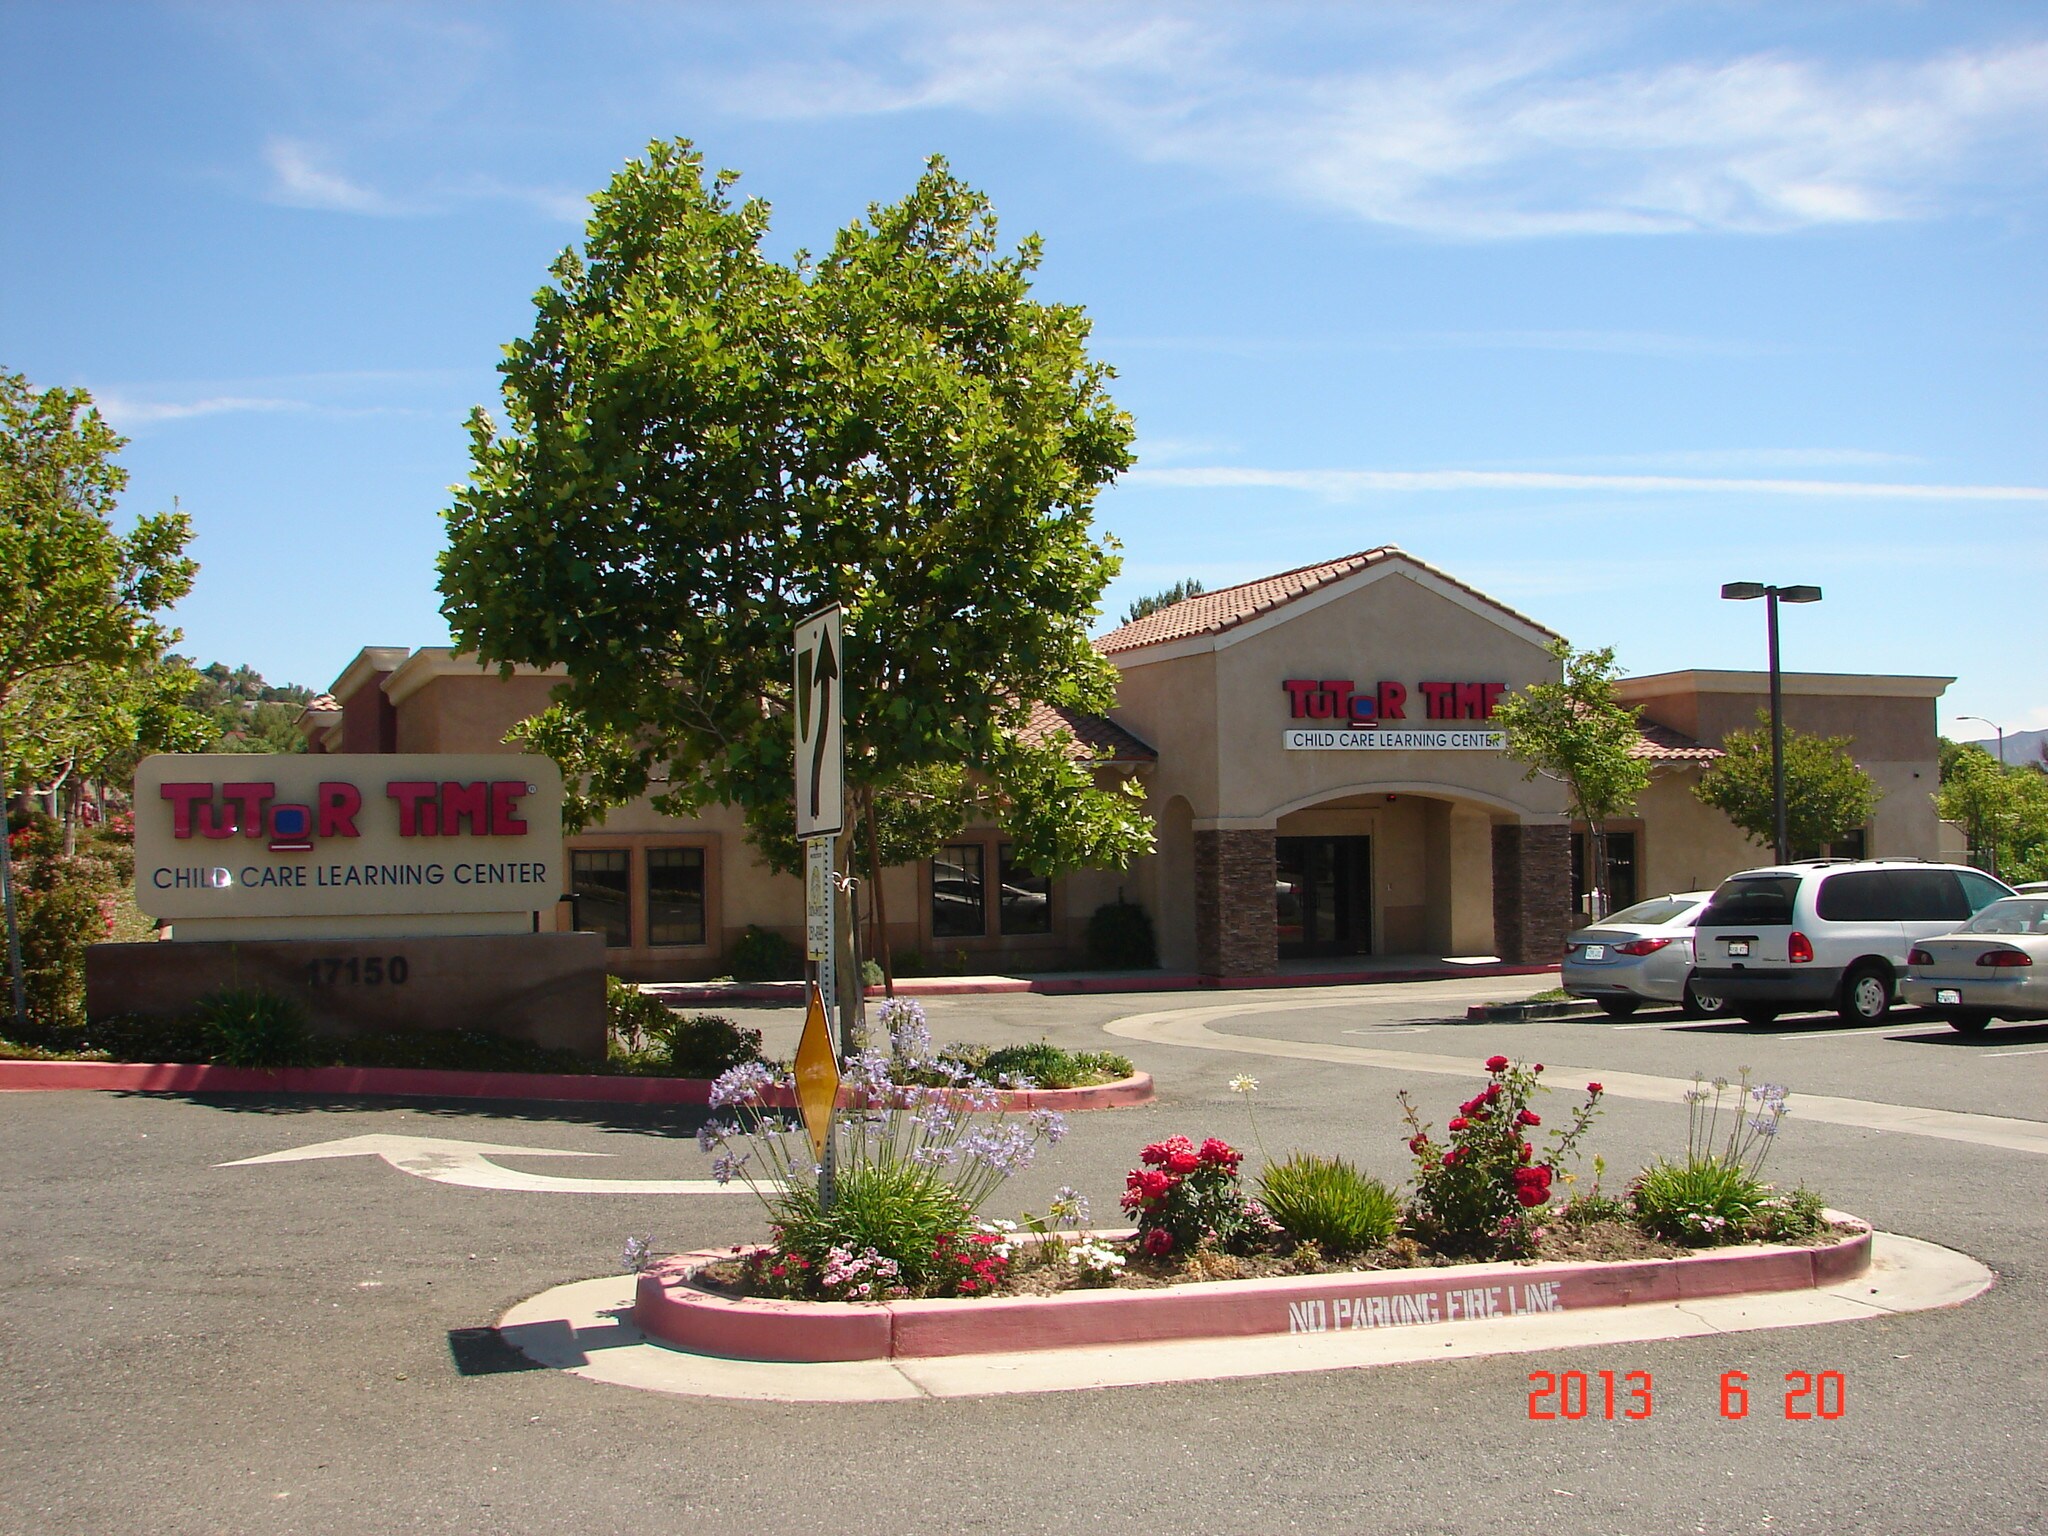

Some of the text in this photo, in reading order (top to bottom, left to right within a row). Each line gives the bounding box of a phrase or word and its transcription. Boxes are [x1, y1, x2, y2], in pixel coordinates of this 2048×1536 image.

[1293, 733, 1335, 747] CHILD
[1339, 733, 1375, 747] CARE
[1380, 733, 1447, 747] LEARNING
[153, 863, 547, 889] CHILD CARE LEARNING CENTER
[304, 955, 409, 987] 17150
[1288, 1299, 1327, 1335] NO
[1332, 1292, 1440, 1331] PARKING
[1446, 1286, 1504, 1322] FIRE
